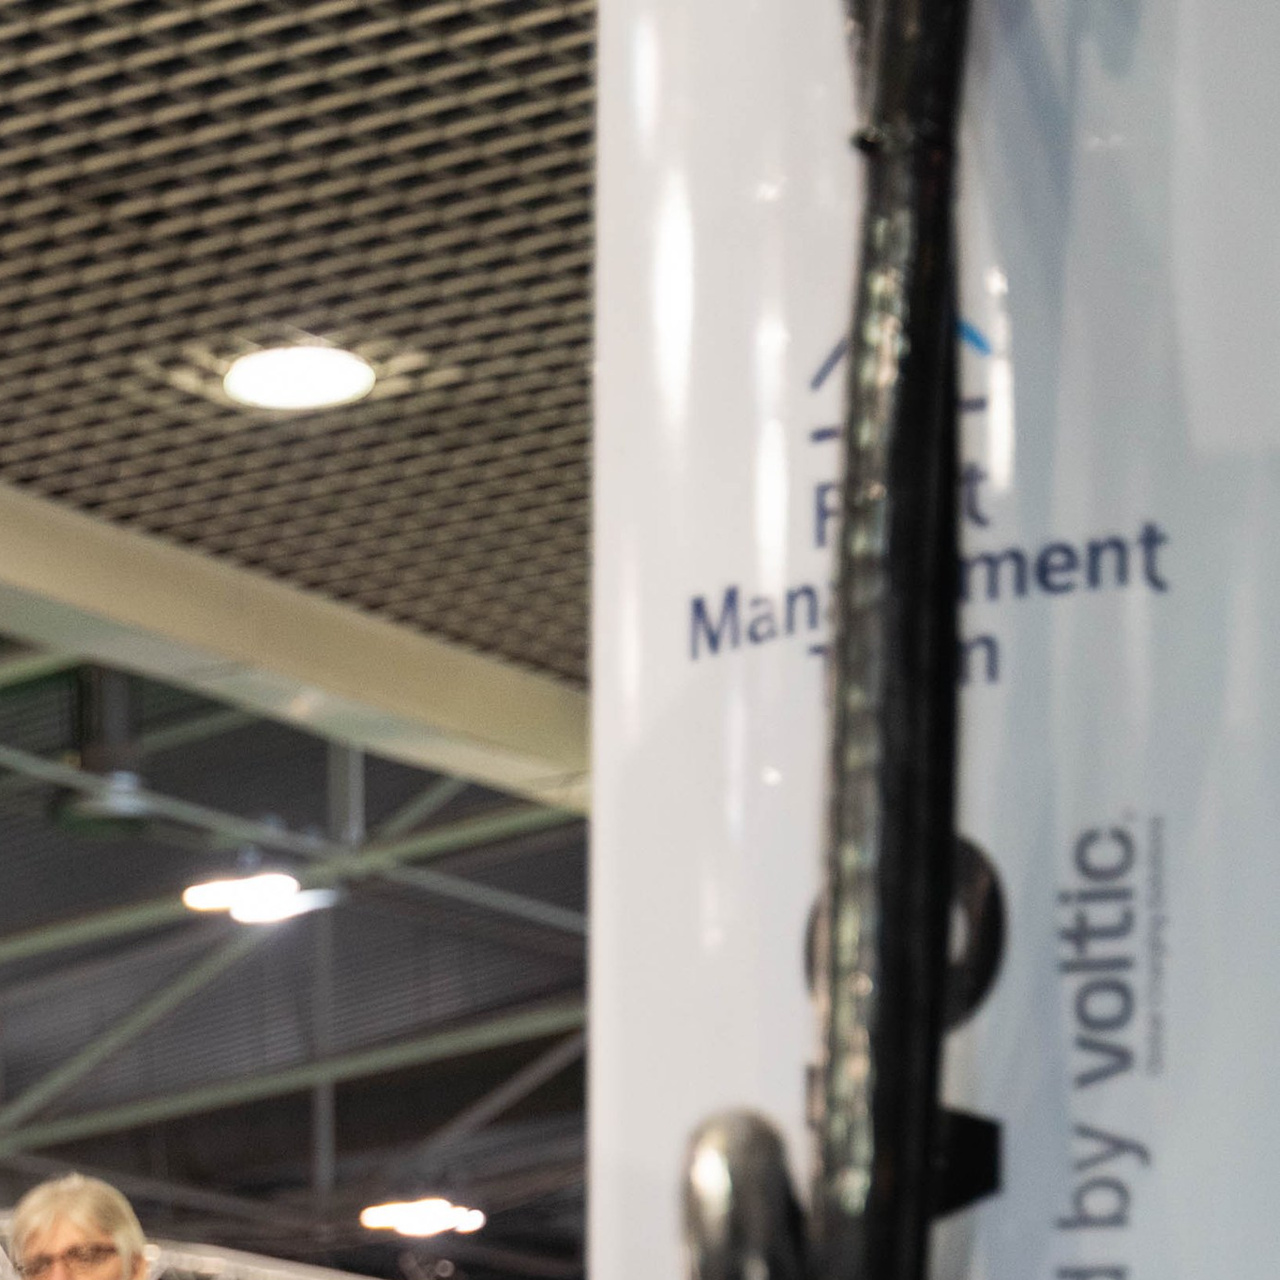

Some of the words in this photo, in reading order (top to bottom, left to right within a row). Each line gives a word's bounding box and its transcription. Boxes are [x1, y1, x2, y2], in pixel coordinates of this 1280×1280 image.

[688, 522, 1170, 662] Manment
[1055, 825, 1137, 1090] voltic
[1054, 1123, 1151, 1232] by
